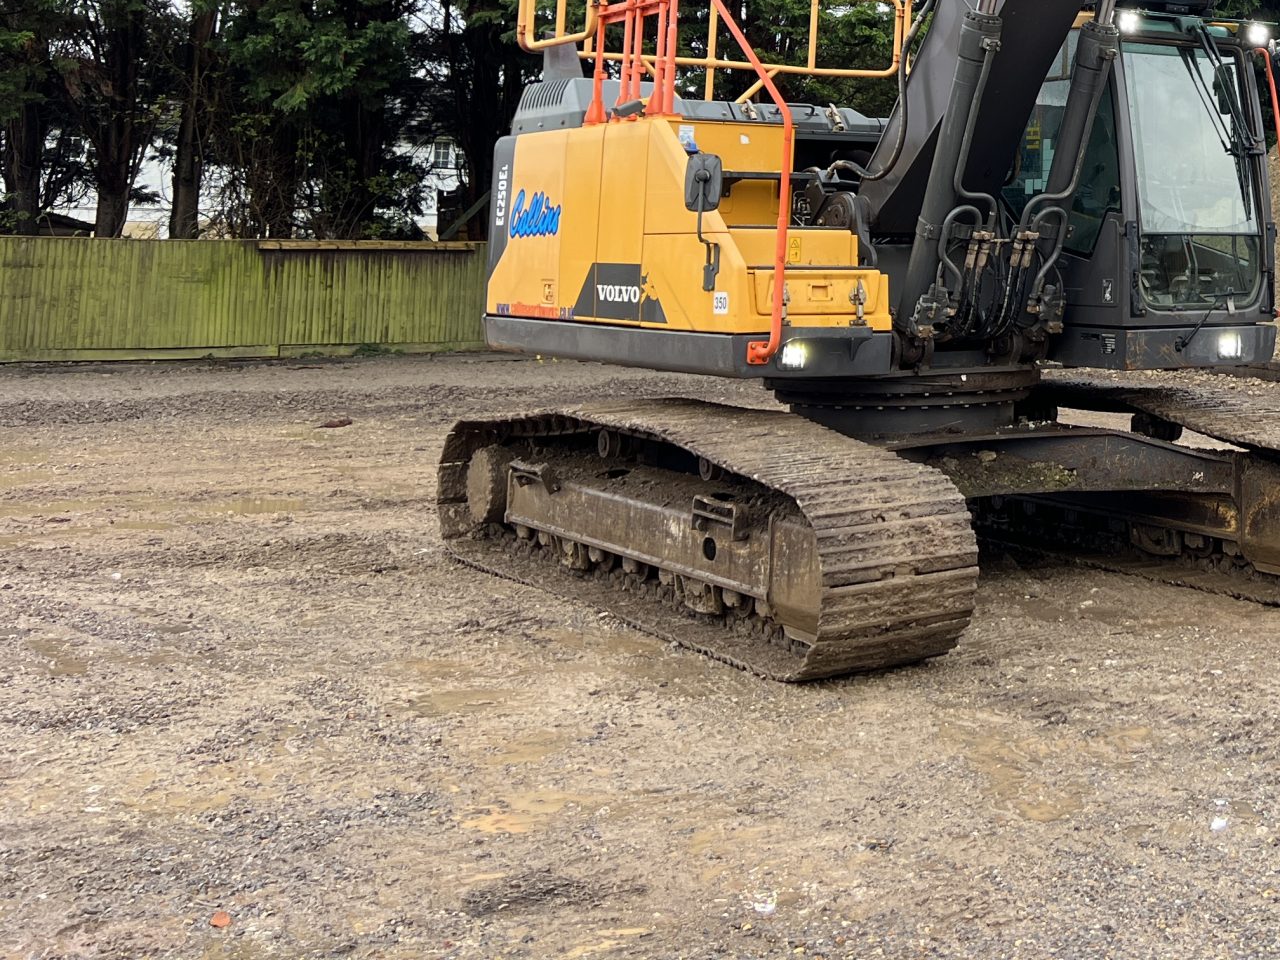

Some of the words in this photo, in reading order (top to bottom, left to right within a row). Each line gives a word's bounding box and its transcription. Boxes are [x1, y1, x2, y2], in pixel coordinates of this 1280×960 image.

[496, 164, 509, 226] EC250EL
[509, 188, 561, 239] Collins
[596, 284, 640, 303] VOLVO
[714, 297, 727, 310] 350
